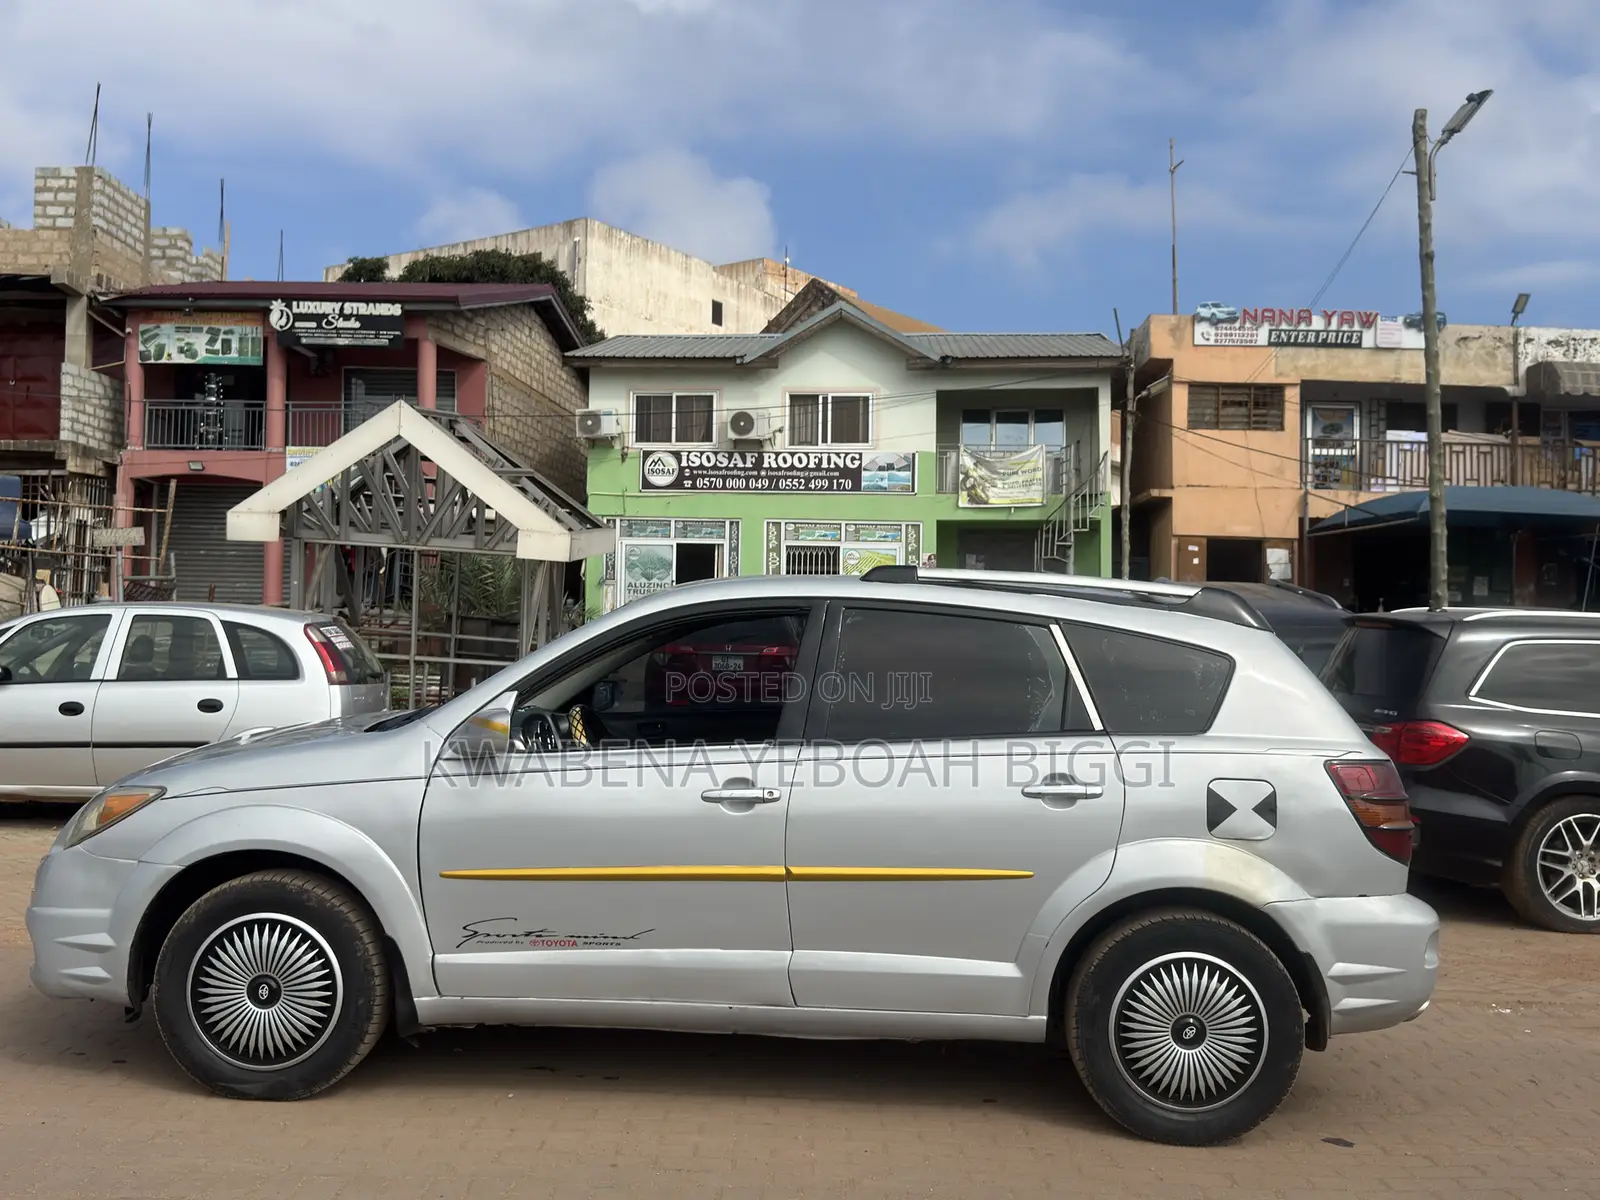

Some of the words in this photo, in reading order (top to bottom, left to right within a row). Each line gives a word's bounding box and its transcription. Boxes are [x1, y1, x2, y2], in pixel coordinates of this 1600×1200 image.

[292, 301, 341, 314] LUXURY
[343, 302, 402, 316] STRANDS
[1242, 307, 1312, 327] NANA
[1321, 309, 1380, 329] YAW
[680, 452, 758, 468] ISOSAF
[762, 452, 861, 469] ROOFING
[647, 467, 676, 475] ISOSAF
[696, 478, 723, 489] 0570
[726, 478, 746, 489] 000
[749, 478, 769, 489] 049
[771, 478, 776, 489] /
[779, 479, 807, 490] 0552
[808, 479, 829, 490] 499
[832, 479, 852, 490] 170
[540, 939, 578, 948] TOYOTA
